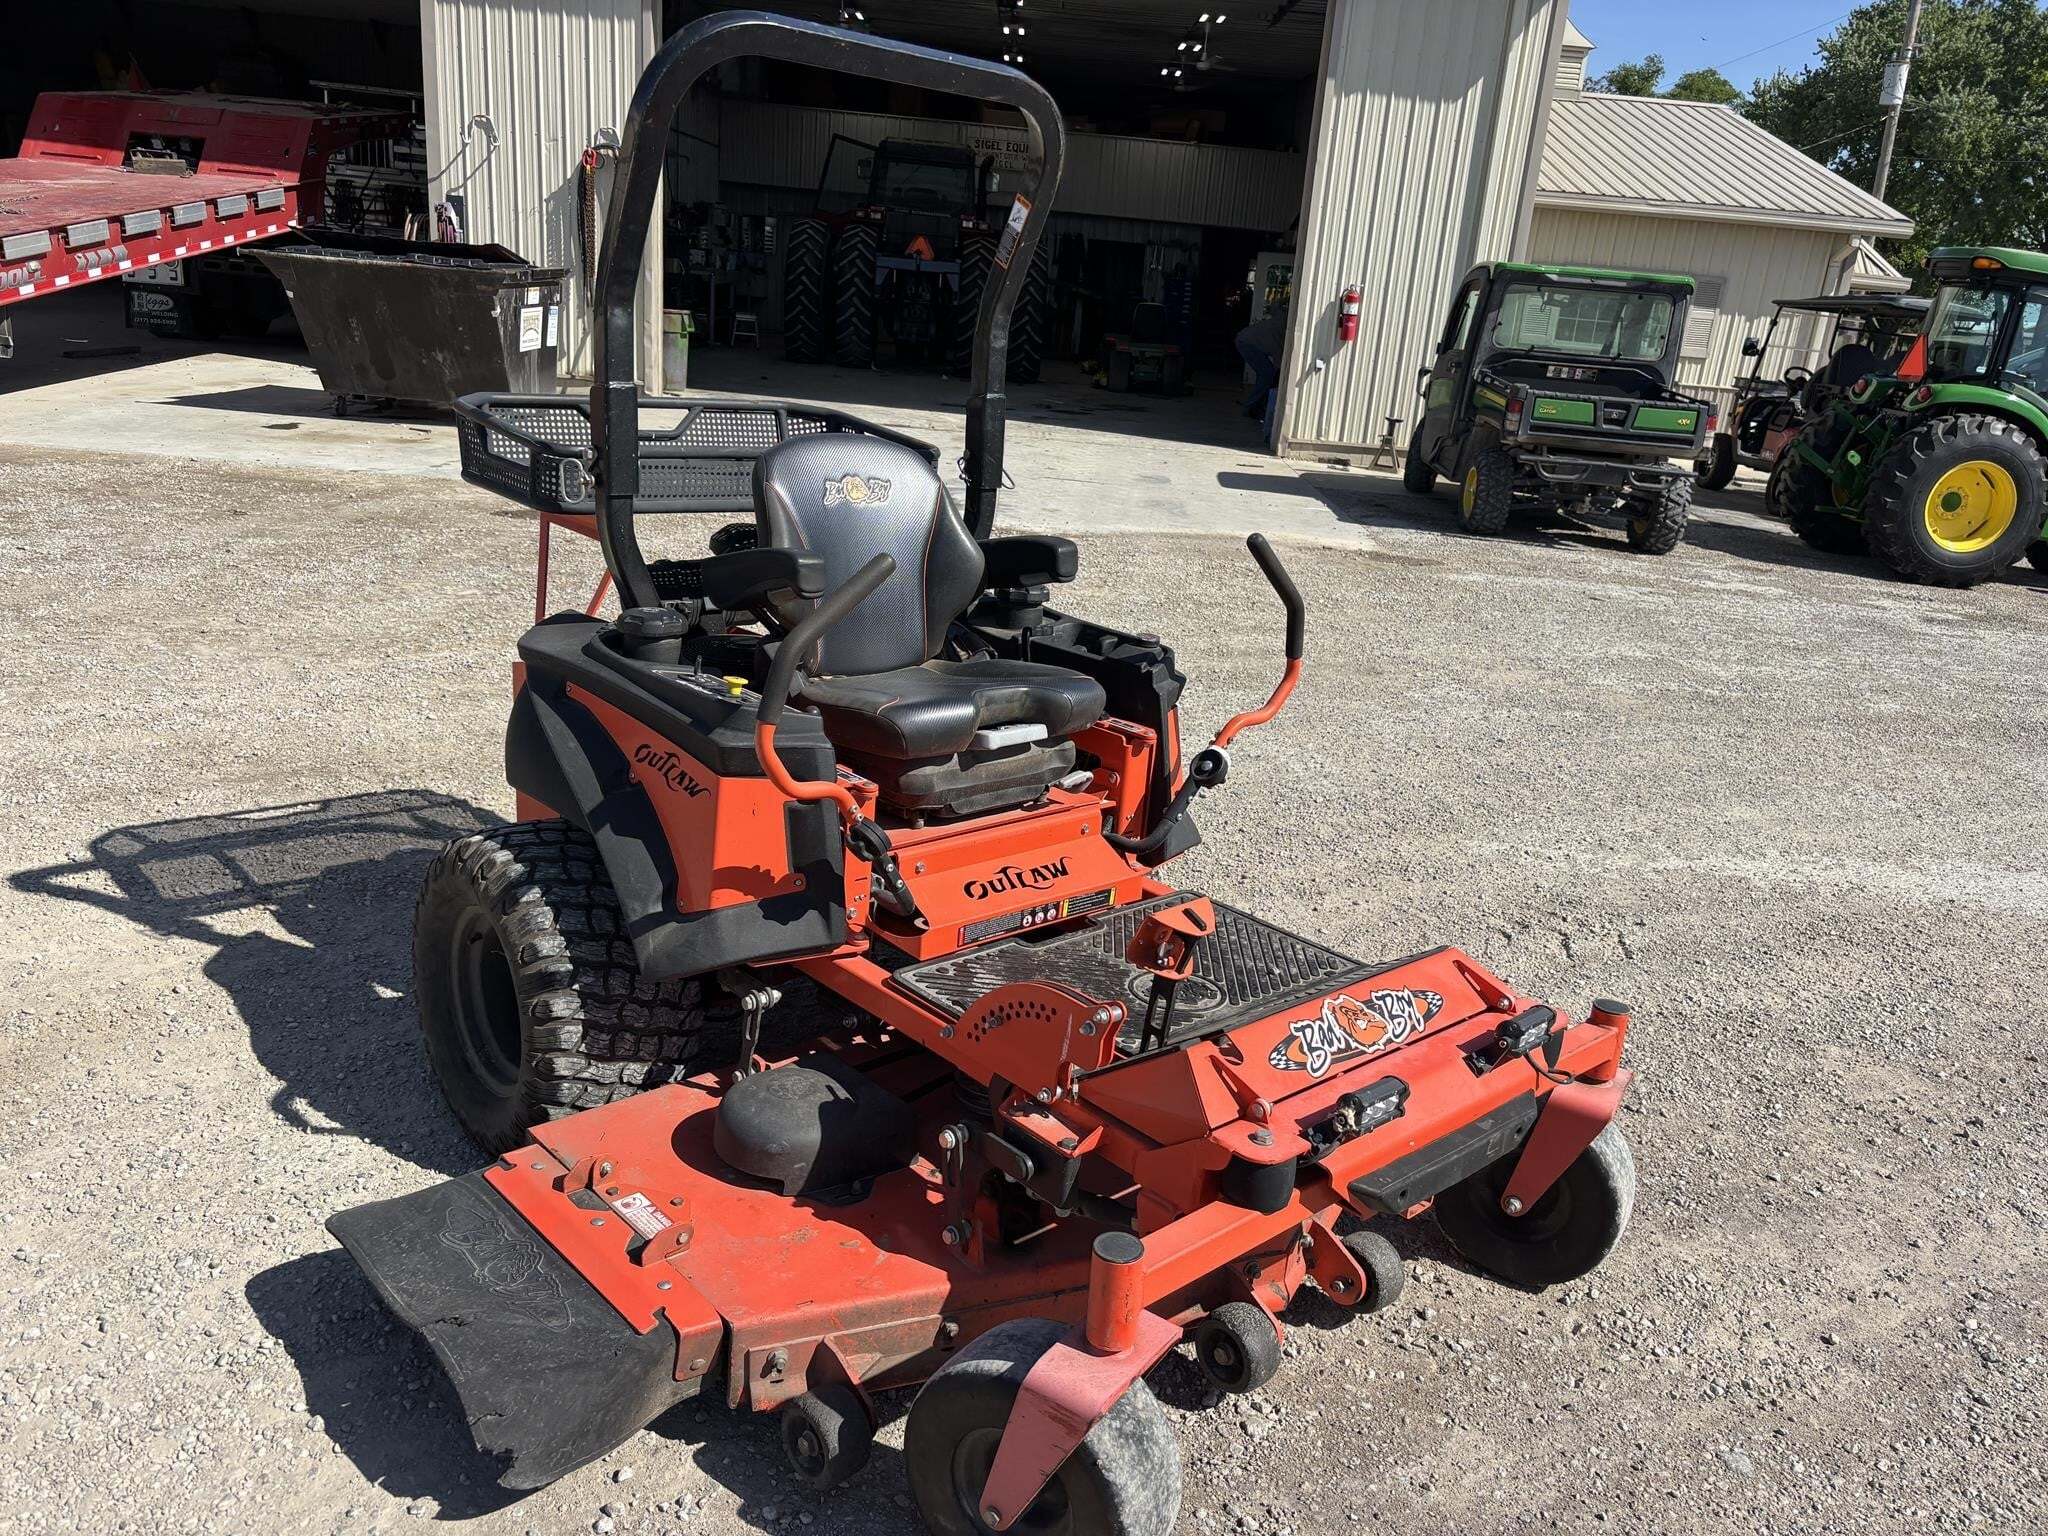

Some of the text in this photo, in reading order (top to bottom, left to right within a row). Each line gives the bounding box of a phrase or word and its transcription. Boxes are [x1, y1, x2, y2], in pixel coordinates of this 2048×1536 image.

[975, 139, 1002, 151] SIGEL
[1290, 985, 1425, 1077] Bad Boy
